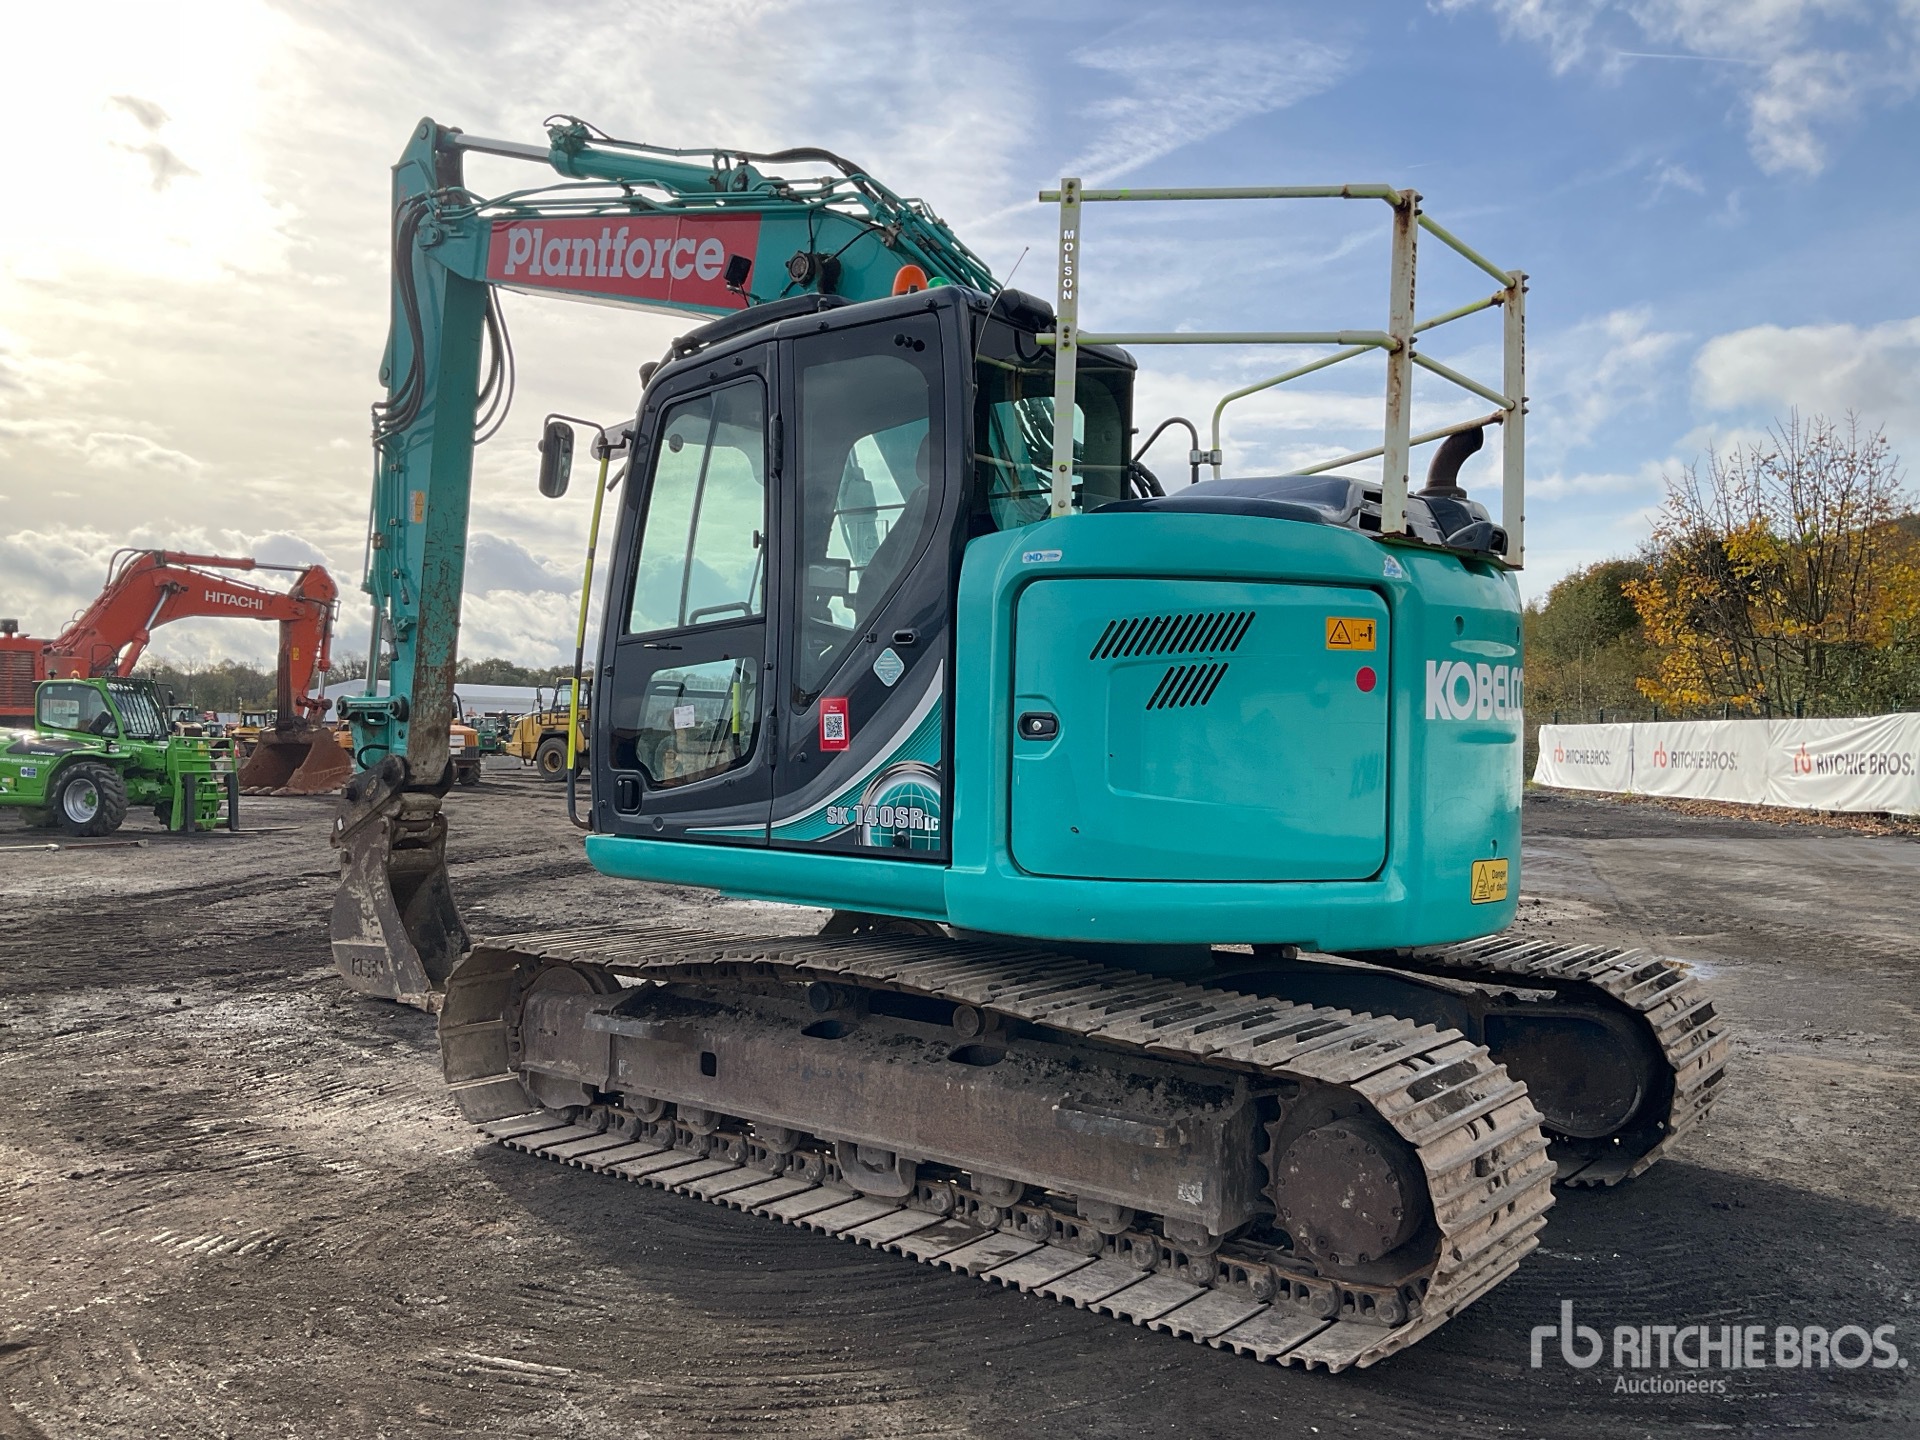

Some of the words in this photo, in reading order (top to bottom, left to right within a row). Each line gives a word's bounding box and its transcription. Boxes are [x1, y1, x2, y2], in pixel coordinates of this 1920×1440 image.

[504, 227, 724, 280] Plantforce
[1063, 230, 1074, 300] MOLSON
[205, 590, 263, 610] HITACHI
[1566, 749, 1589, 765] RITCHIE
[1671, 751, 1703, 769] RITCHIE
[1817, 753, 1867, 774] RITCHIE
[827, 806, 849, 824] SK
